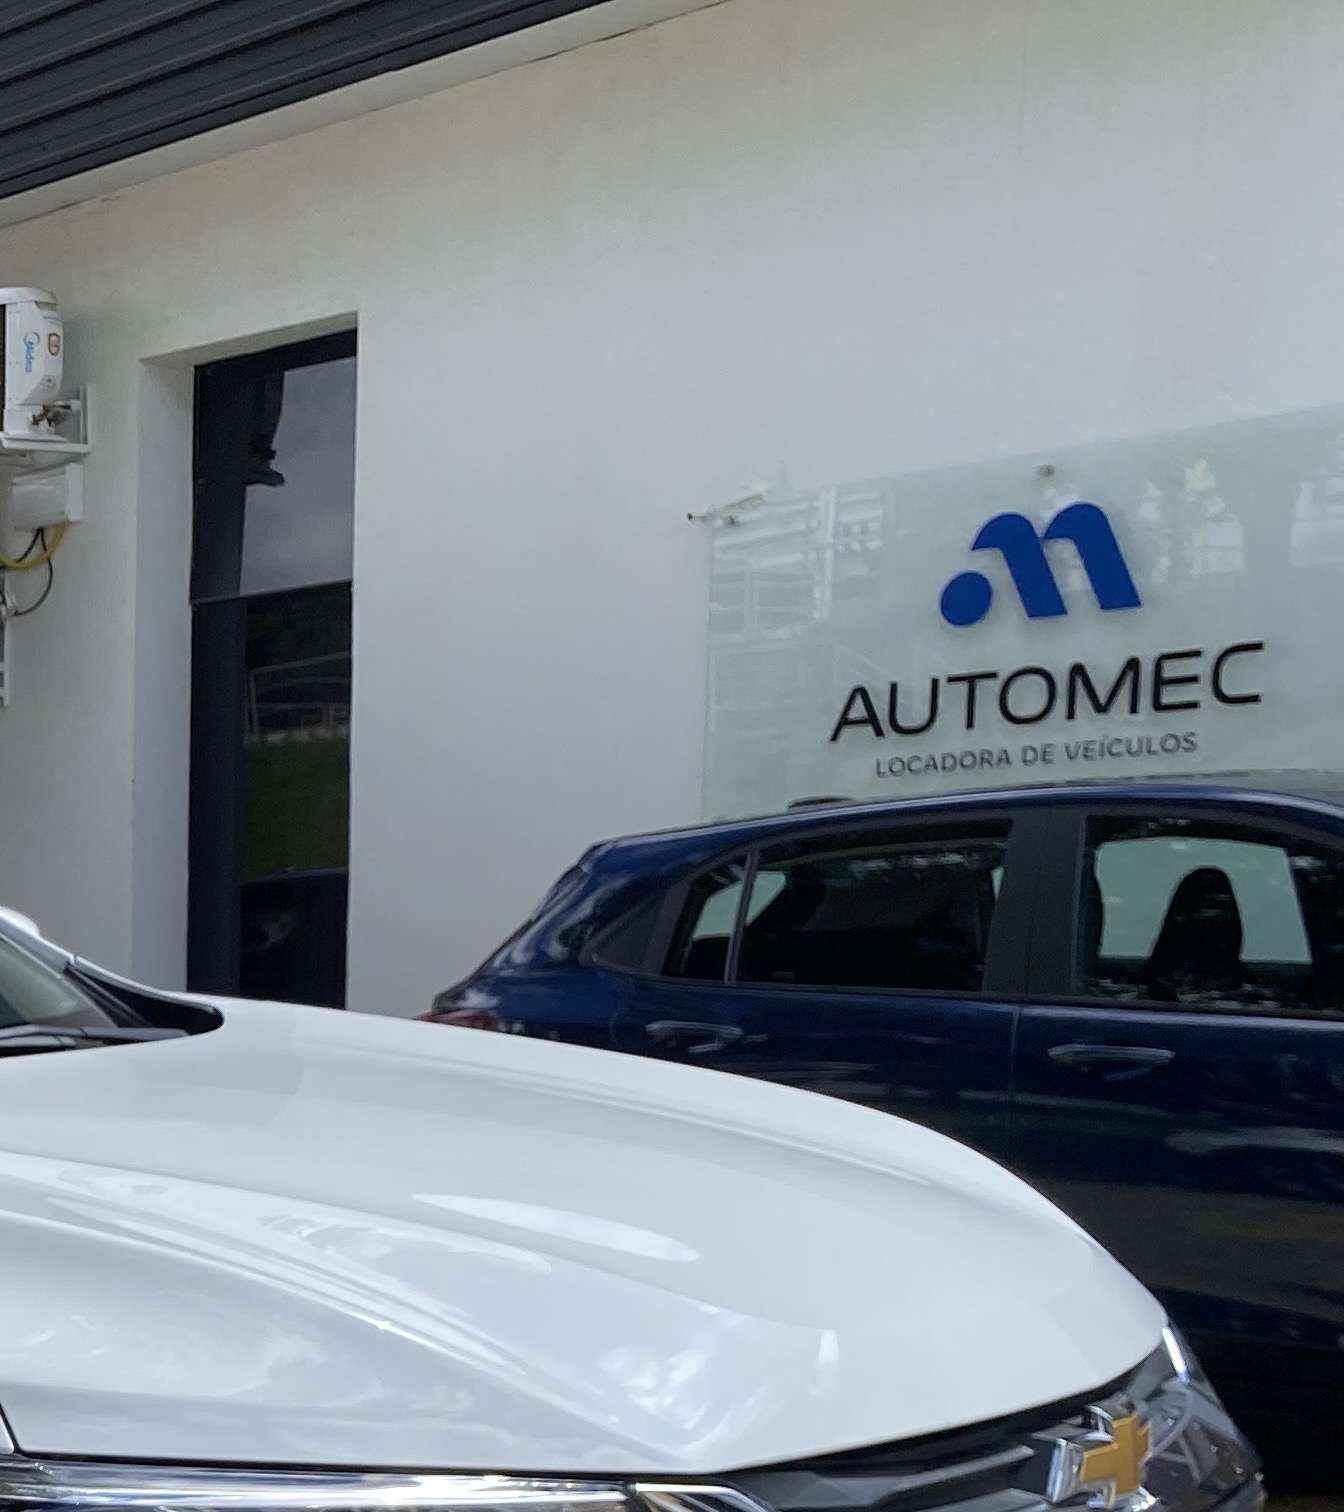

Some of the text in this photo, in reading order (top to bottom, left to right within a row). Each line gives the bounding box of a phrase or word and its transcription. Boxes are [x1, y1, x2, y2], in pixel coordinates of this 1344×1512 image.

[829, 641, 1265, 744] AUTOMEC
[874, 731, 1199, 779] LOCADORA DE VEÍCULOS
